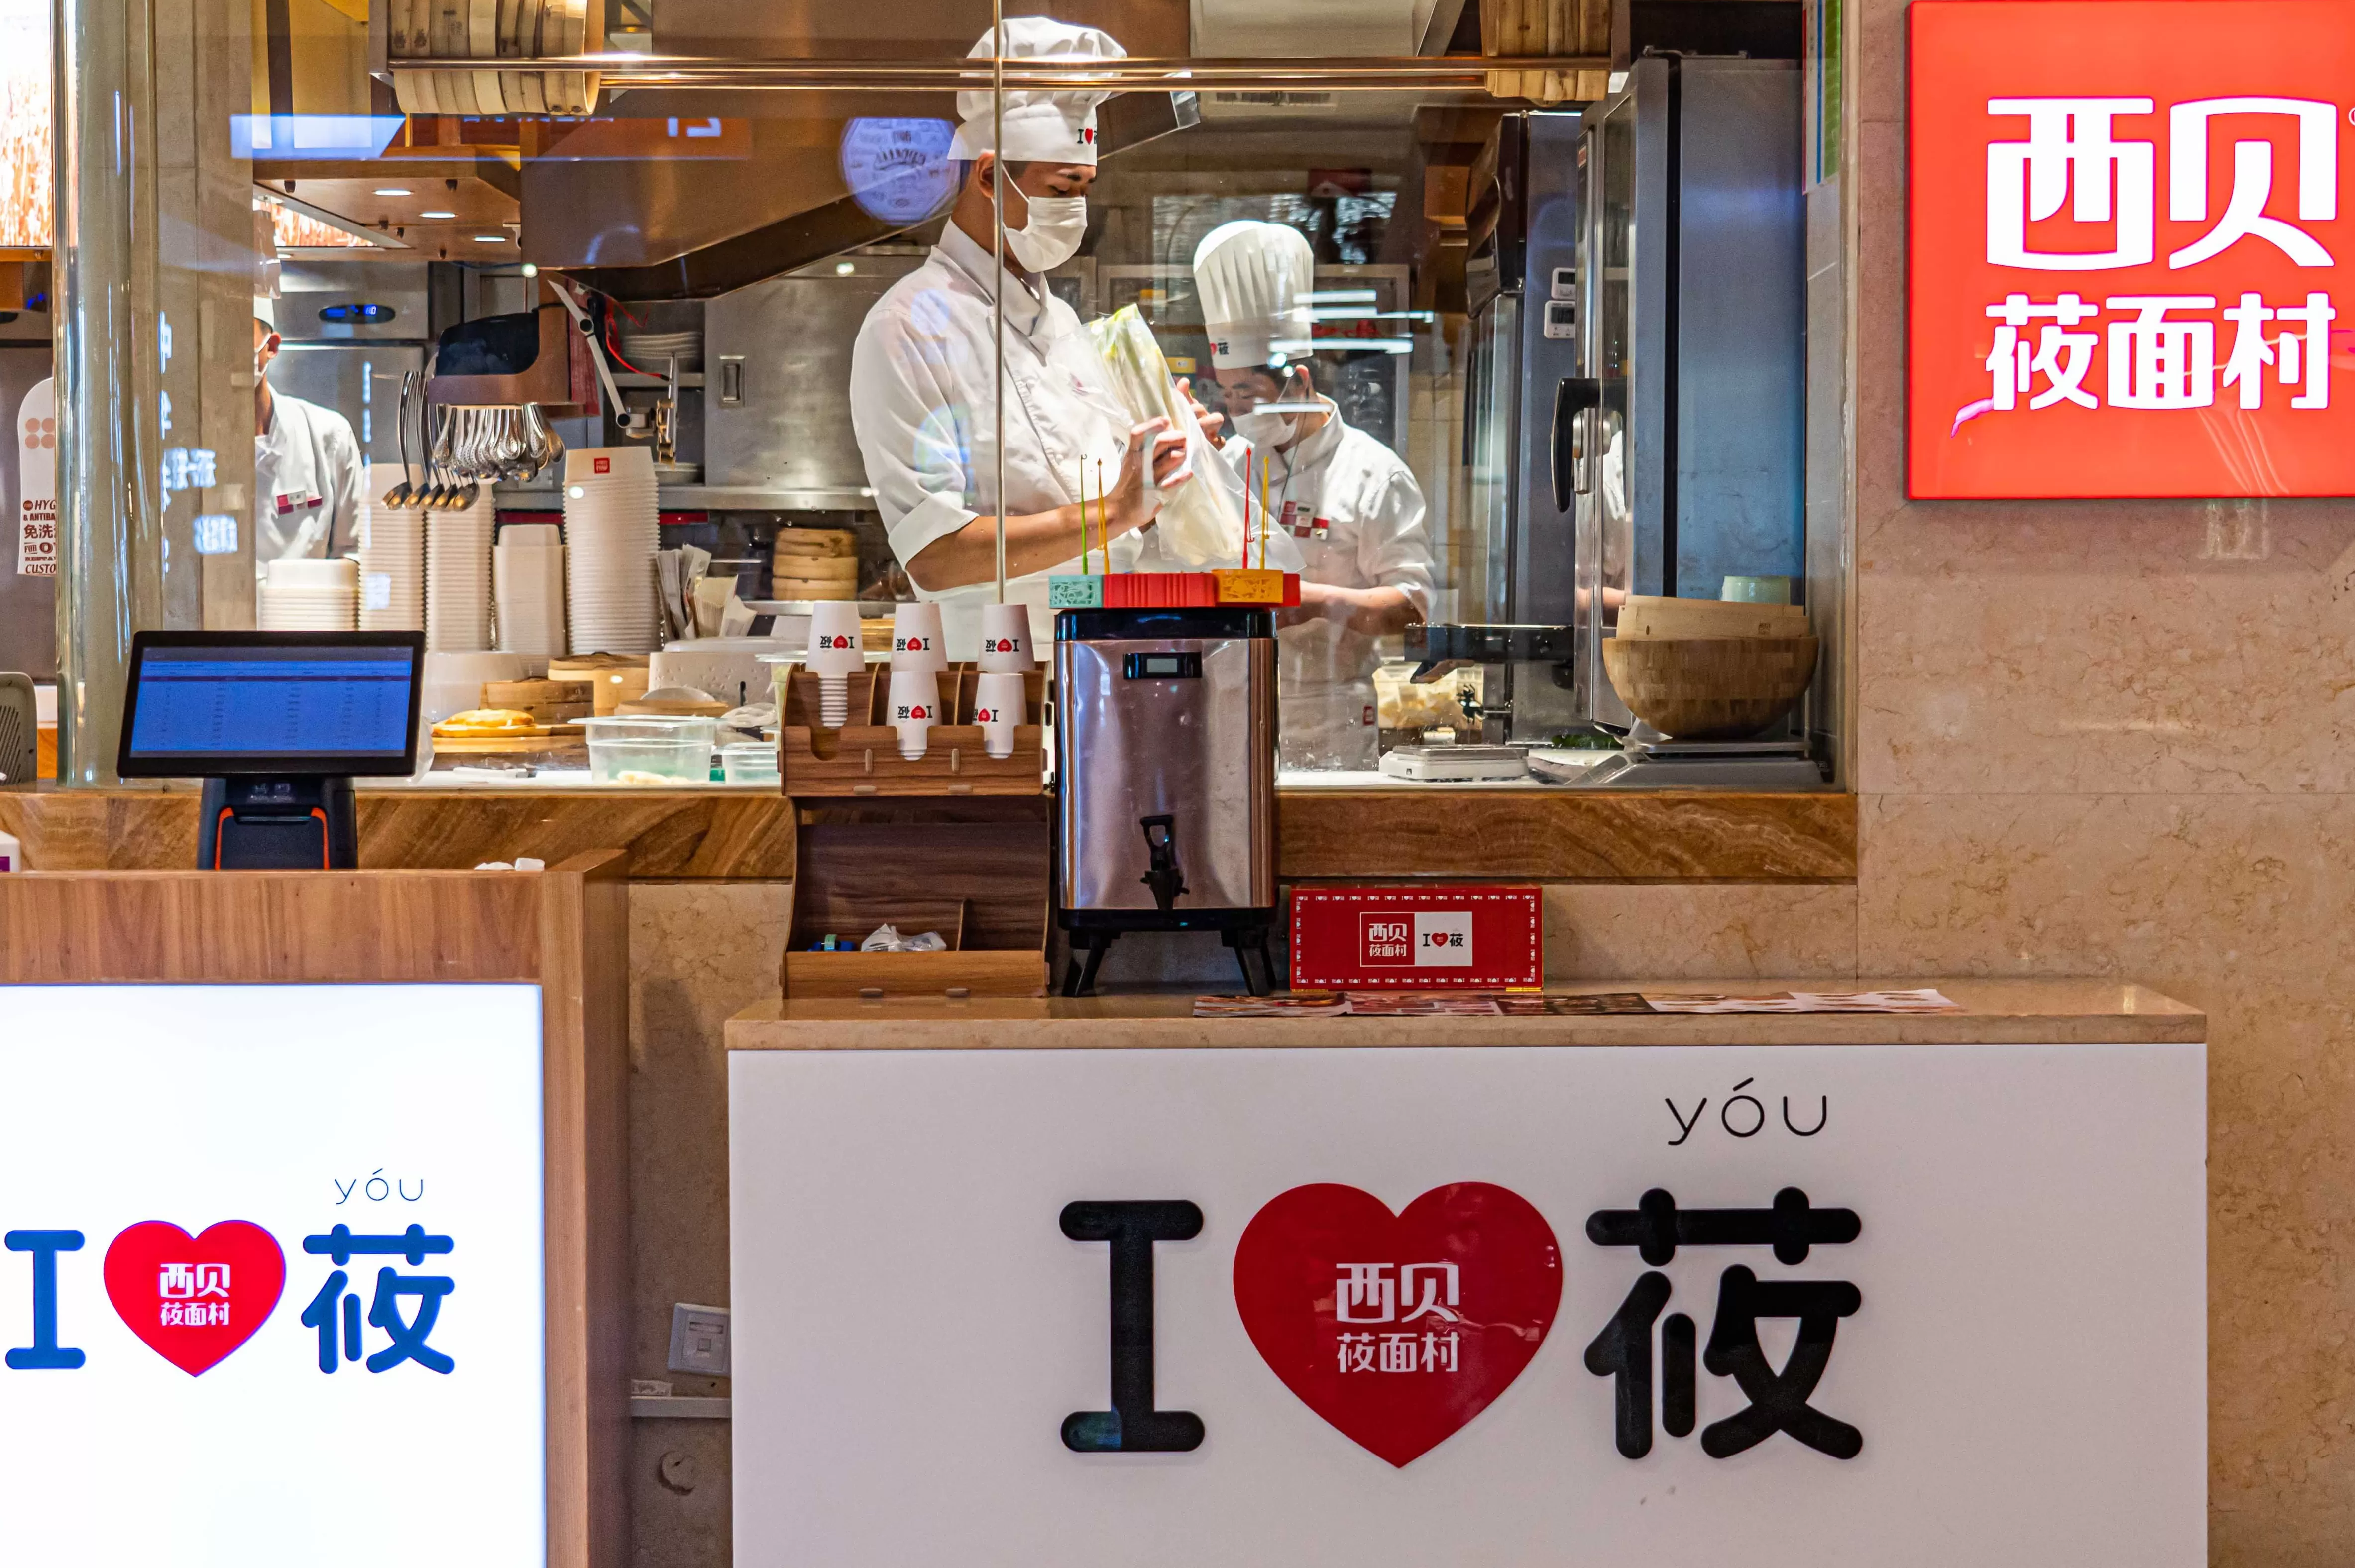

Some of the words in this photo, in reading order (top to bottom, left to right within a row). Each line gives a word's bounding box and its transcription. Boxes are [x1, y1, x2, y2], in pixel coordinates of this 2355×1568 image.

[1987, 97, 2337, 271] 西贝
[1986, 293, 2336, 411] 莜面村
[24, 524, 56, 539] 免洗
[39, 542, 56, 554] O
[1369, 923, 1407, 942] 西贝
[1369, 944, 1407, 957] 莜面村
[1422, 933, 1430, 947] I
[1449, 933, 1463, 947] 莜
[1664, 1077, 1827, 1146] yóu
[334, 1168, 423, 1205] yóu
[4, 1230, 86, 1370] I
[301, 1223, 455, 1375] 莜
[160, 1263, 230, 1299] 西贝
[1336, 1262, 1459, 1324] 西贝
[160, 1302, 230, 1326] 莜面村
[1059, 1199, 1205, 1453] I
[1583, 1186, 1863, 1460] 莜
[1337, 1332, 1459, 1373] 莜面村
